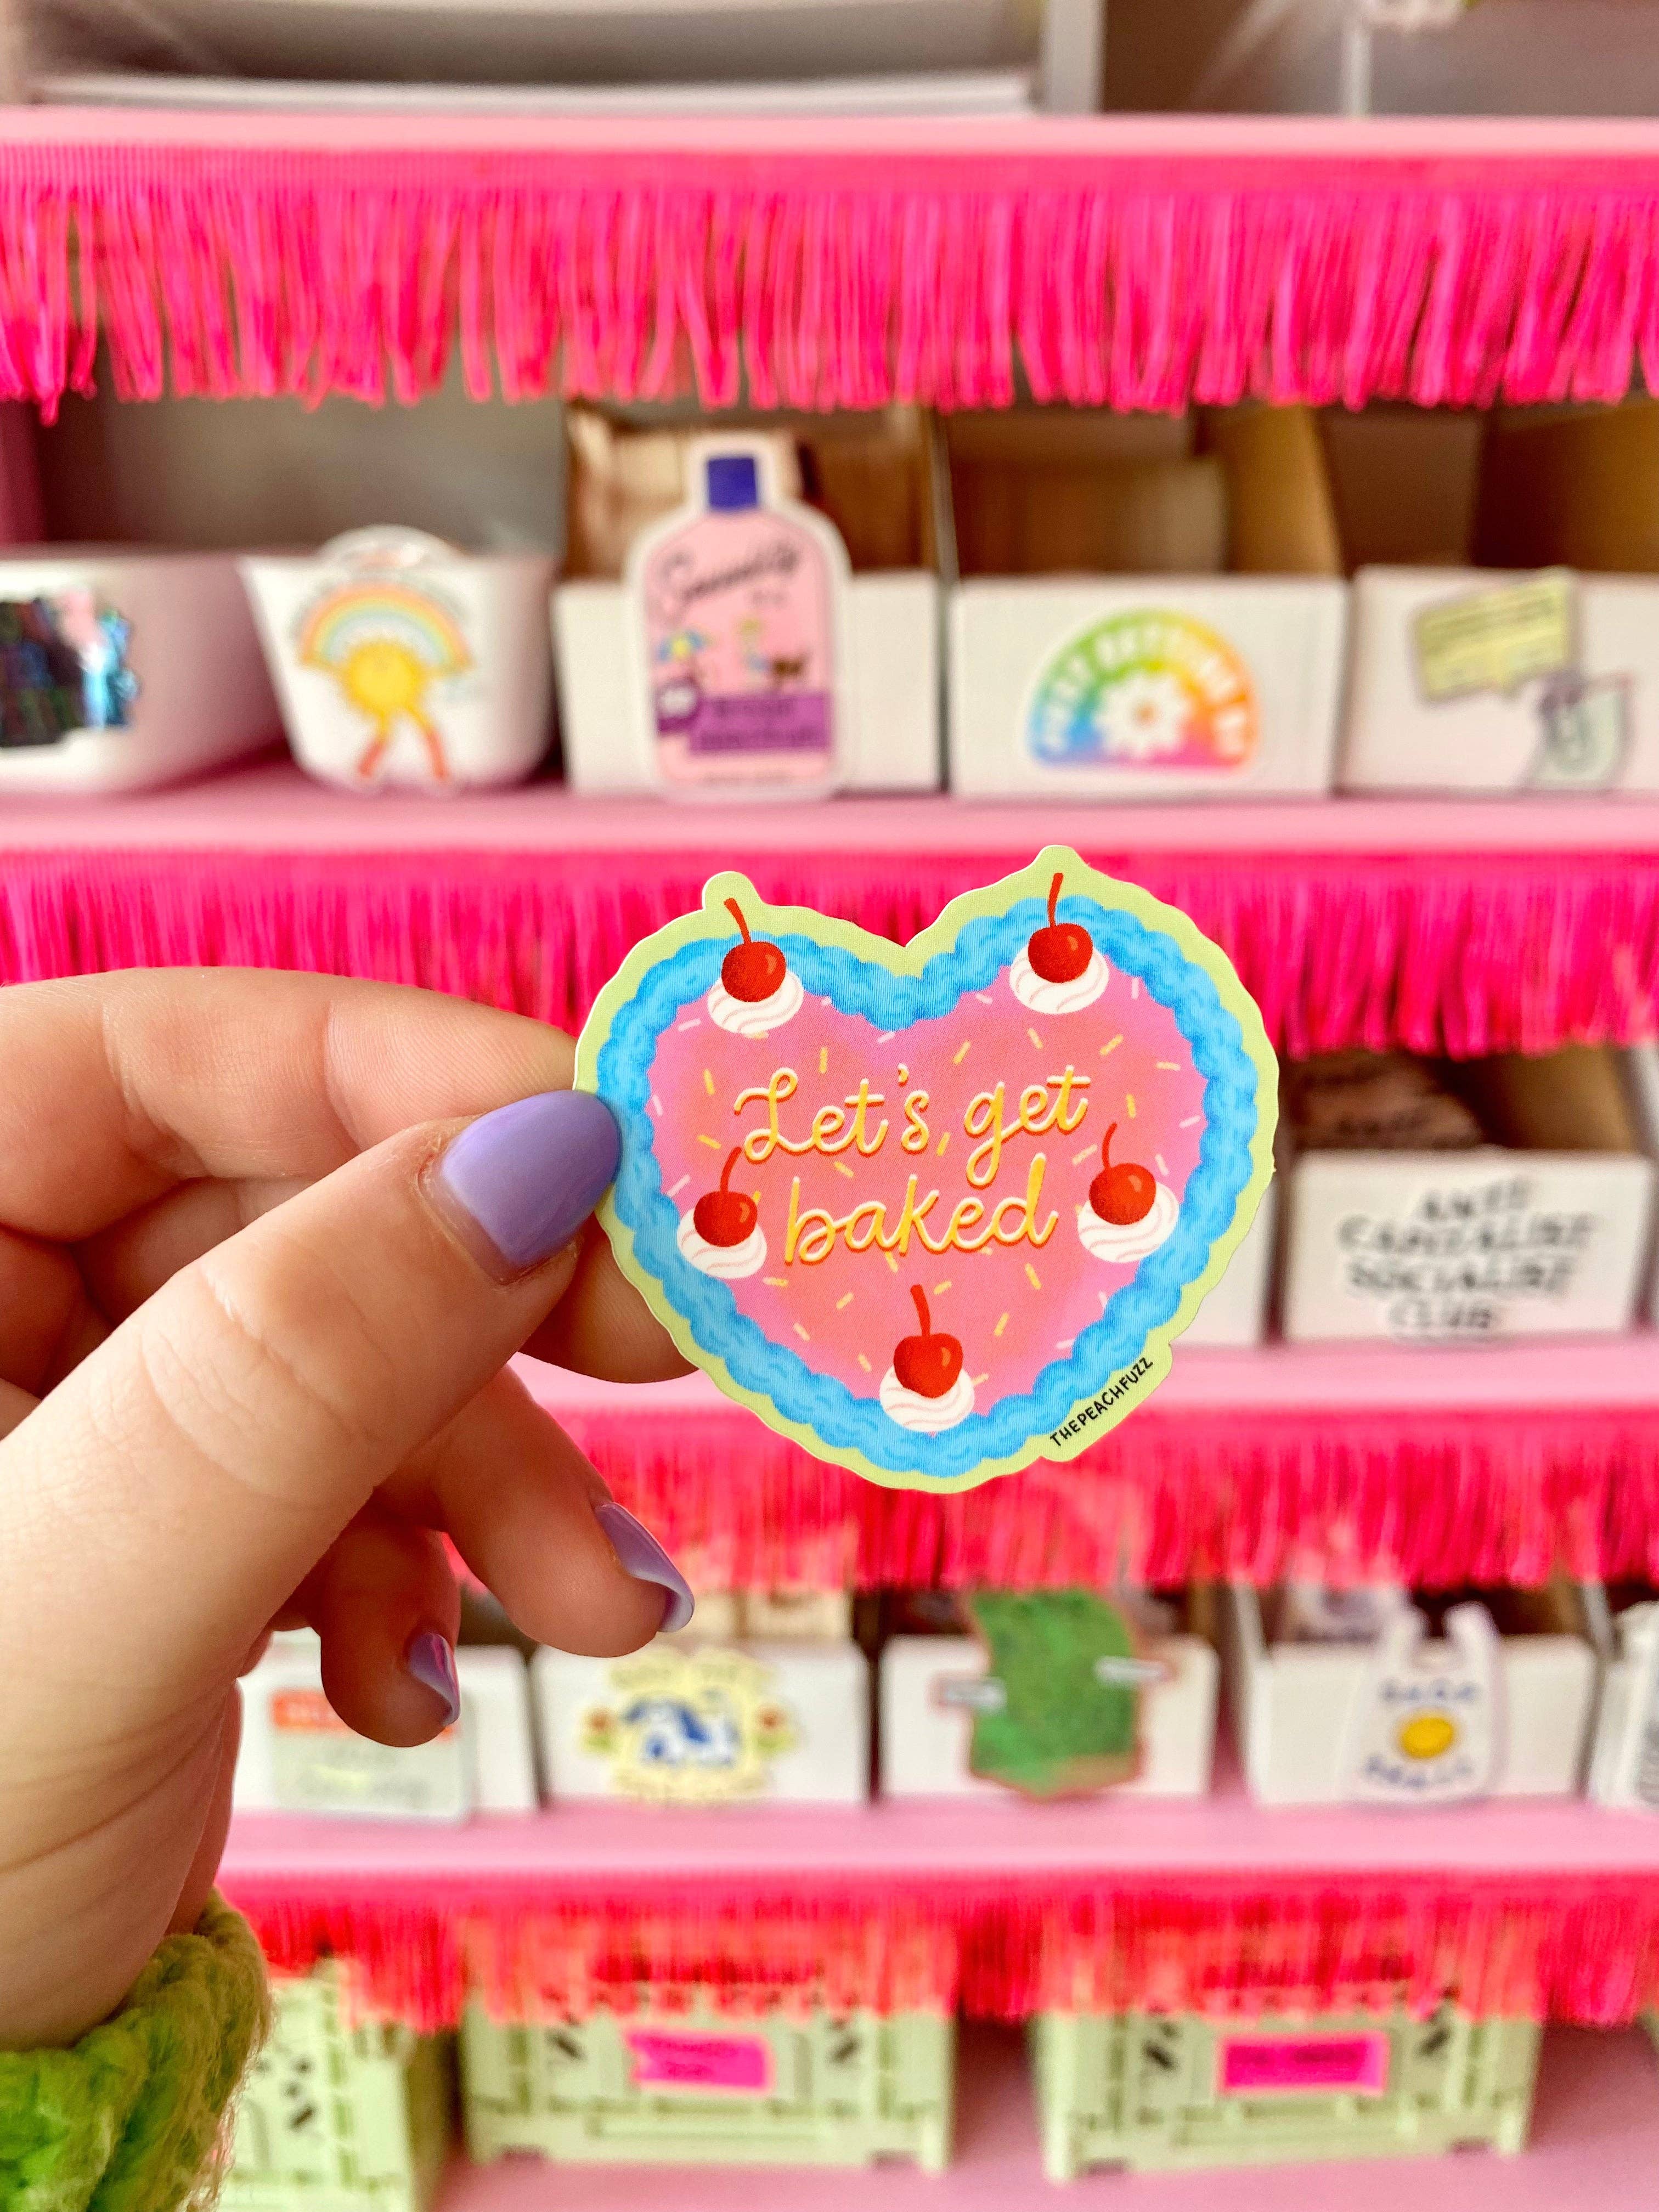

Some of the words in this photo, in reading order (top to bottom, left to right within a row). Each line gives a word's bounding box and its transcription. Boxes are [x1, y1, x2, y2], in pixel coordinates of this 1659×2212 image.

[733, 1063, 930, 1164] Let's
[963, 1064, 1091, 1189] get
[785, 1152, 1059, 1266] baked
[1049, 1357, 1154, 1447] THEPEACHFUZZ
